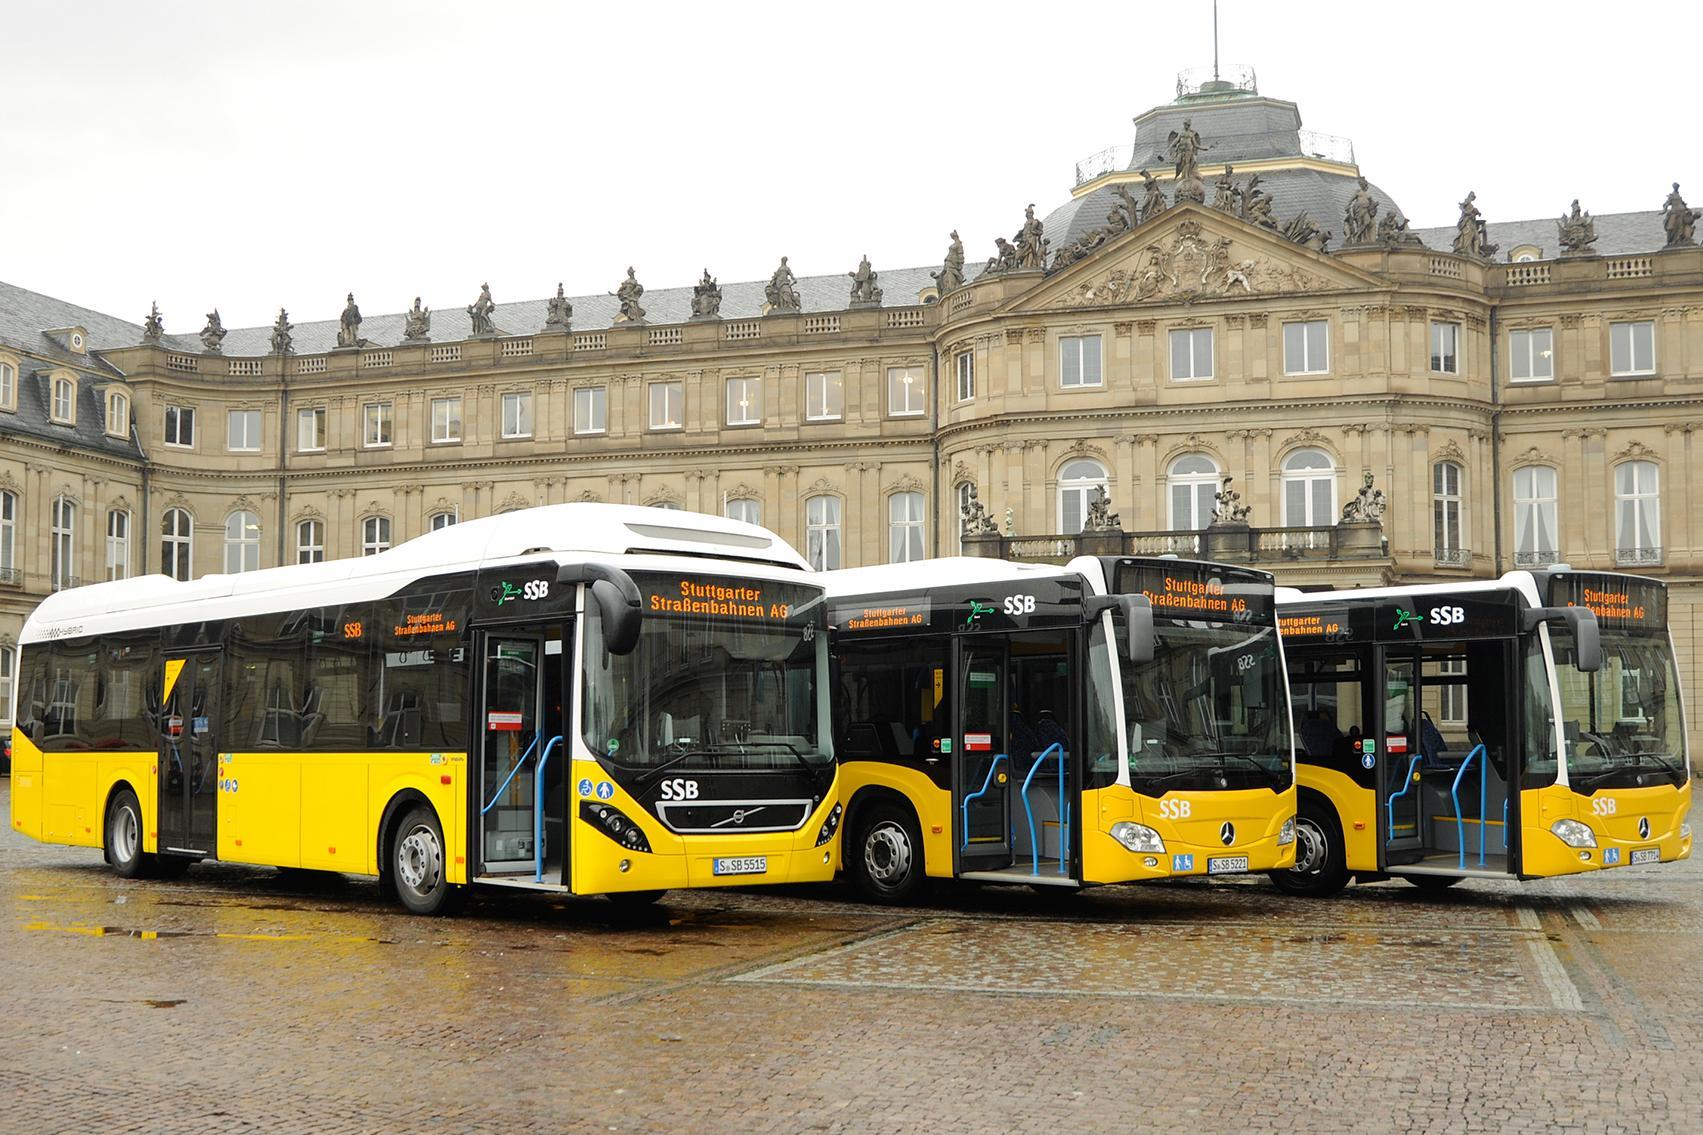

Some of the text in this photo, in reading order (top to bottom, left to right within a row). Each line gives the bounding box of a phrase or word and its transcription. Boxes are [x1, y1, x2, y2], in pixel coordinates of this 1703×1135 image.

[523, 579, 549, 600] SSB
[680, 581, 761, 601] Stuttgarter
[1165, 577, 1225, 596] Stuttgarter
[1584, 588, 1628, 605] Stuttgarter
[651, 595, 788, 619] Straßenbahnen AG
[863, 608, 906, 618] Stuttgarter
[1003, 594, 1036, 616] SSB
[1231, 599, 1246, 612] AG
[1633, 606, 1645, 619] AG
[406, 613, 442, 624] Stuttgarter
[848, 614, 922, 630] Straßenbahnen AG
[1278, 616, 1321, 627] tuttgarter
[1430, 606, 1465, 626] SSB
[344, 622, 362, 638] SSB
[394, 620, 456, 636] Straßenbahnen AG
[1279, 625, 1323, 636] enbahnen
[1326, 623, 1339, 633] AG
[660, 778, 699, 801] SSB
[1159, 798, 1191, 819] SSB
[1592, 797, 1616, 816] SSB
[719, 858, 766, 872] S SB 5515
[1212, 858, 1246, 870] S SB 5221
